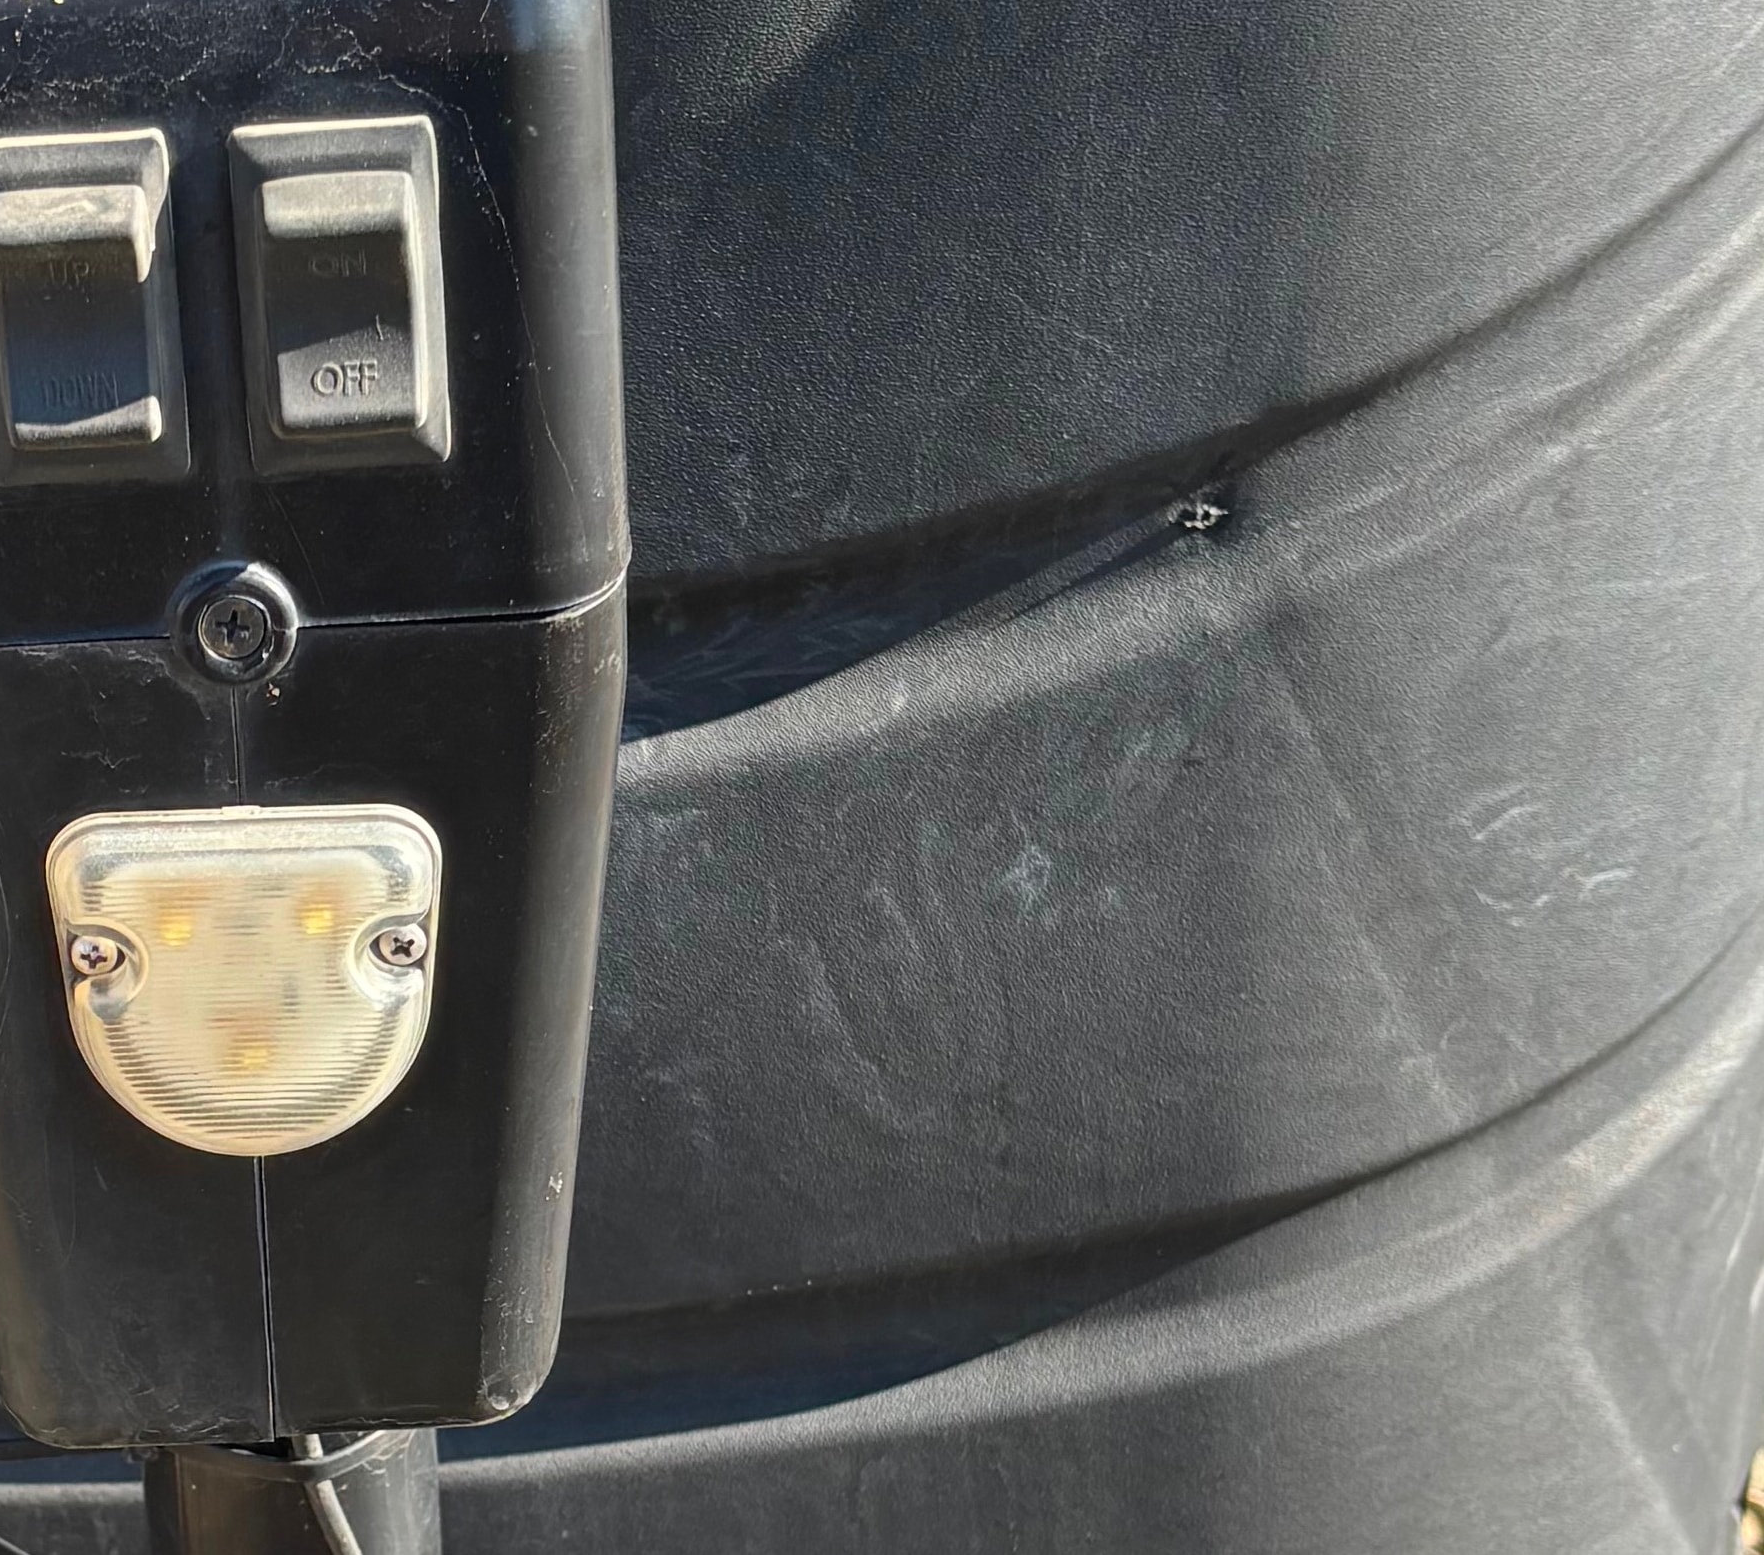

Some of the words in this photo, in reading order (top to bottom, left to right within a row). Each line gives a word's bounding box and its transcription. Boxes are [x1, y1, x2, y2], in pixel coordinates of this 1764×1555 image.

[48, 261, 90, 287] UP
[310, 249, 367, 277] ON
[41, 371, 120, 409] DOWN
[311, 359, 379, 398] OFF
